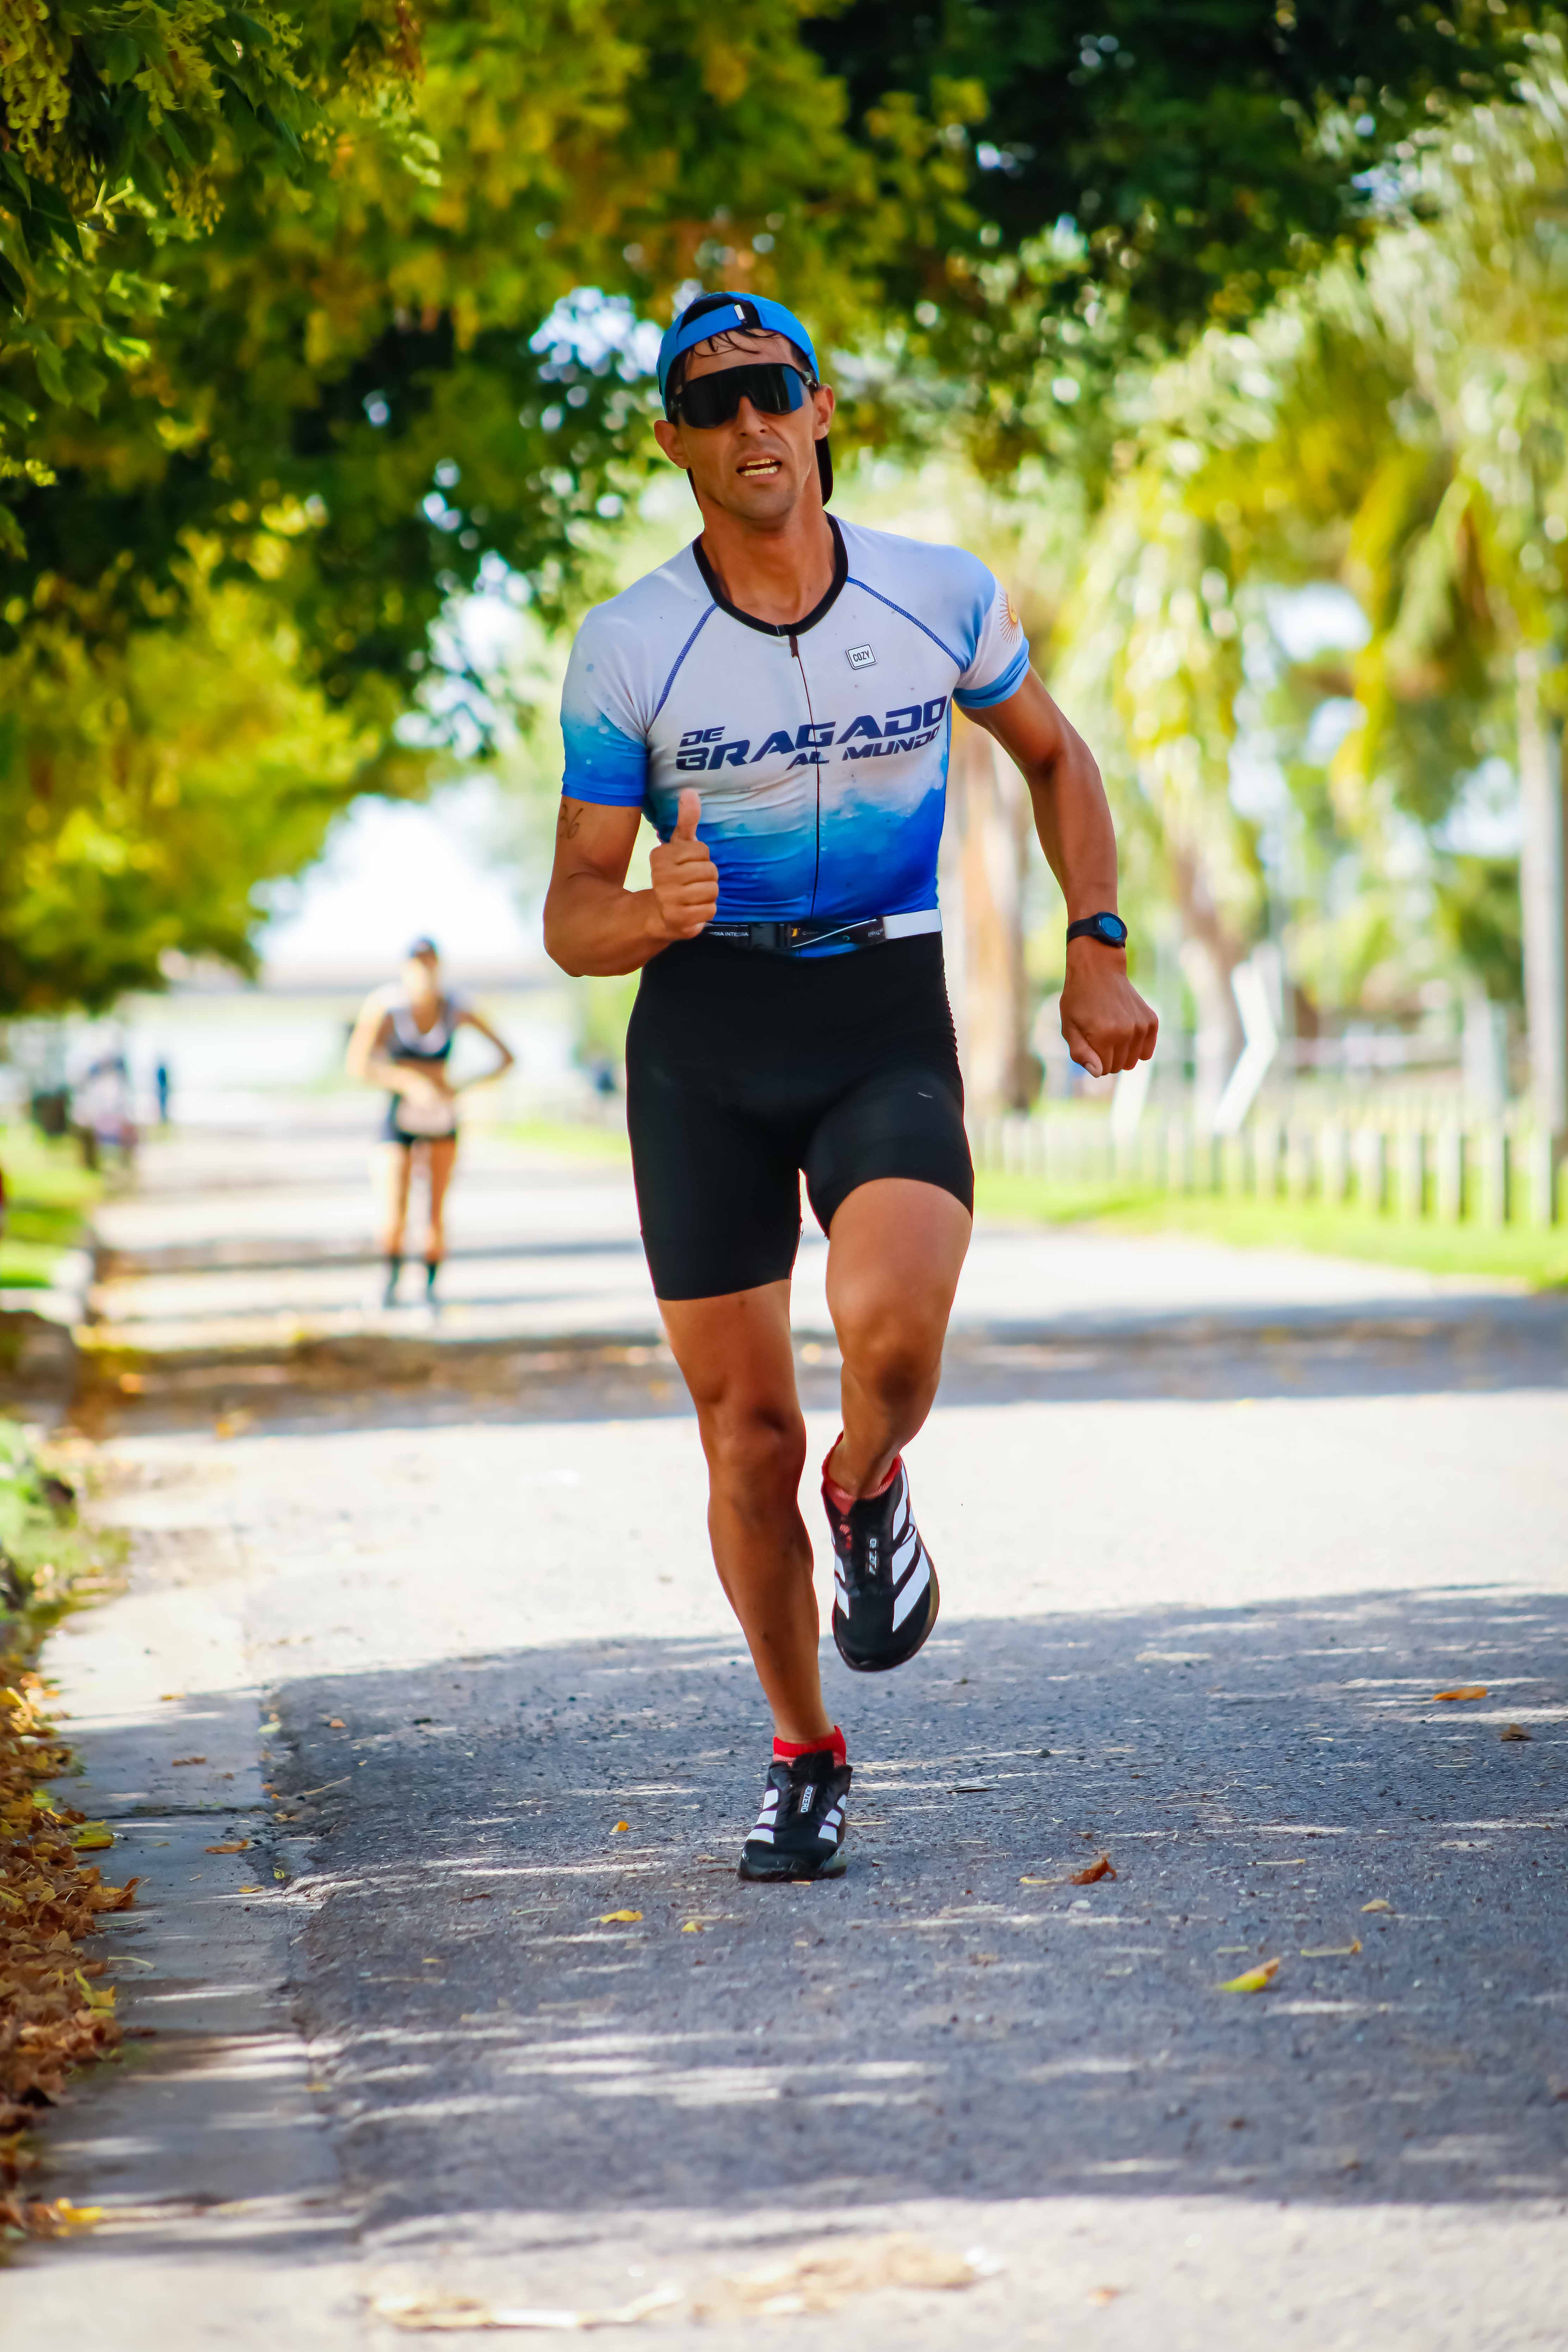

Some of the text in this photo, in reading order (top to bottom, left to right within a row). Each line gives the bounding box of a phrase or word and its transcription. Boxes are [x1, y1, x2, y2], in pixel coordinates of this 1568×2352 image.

[853, 650, 870, 662] COZY
[676, 695, 947, 771] BRAGADO
[679, 726, 726, 747] DE
[785, 724, 940, 771] AL MUNDO
